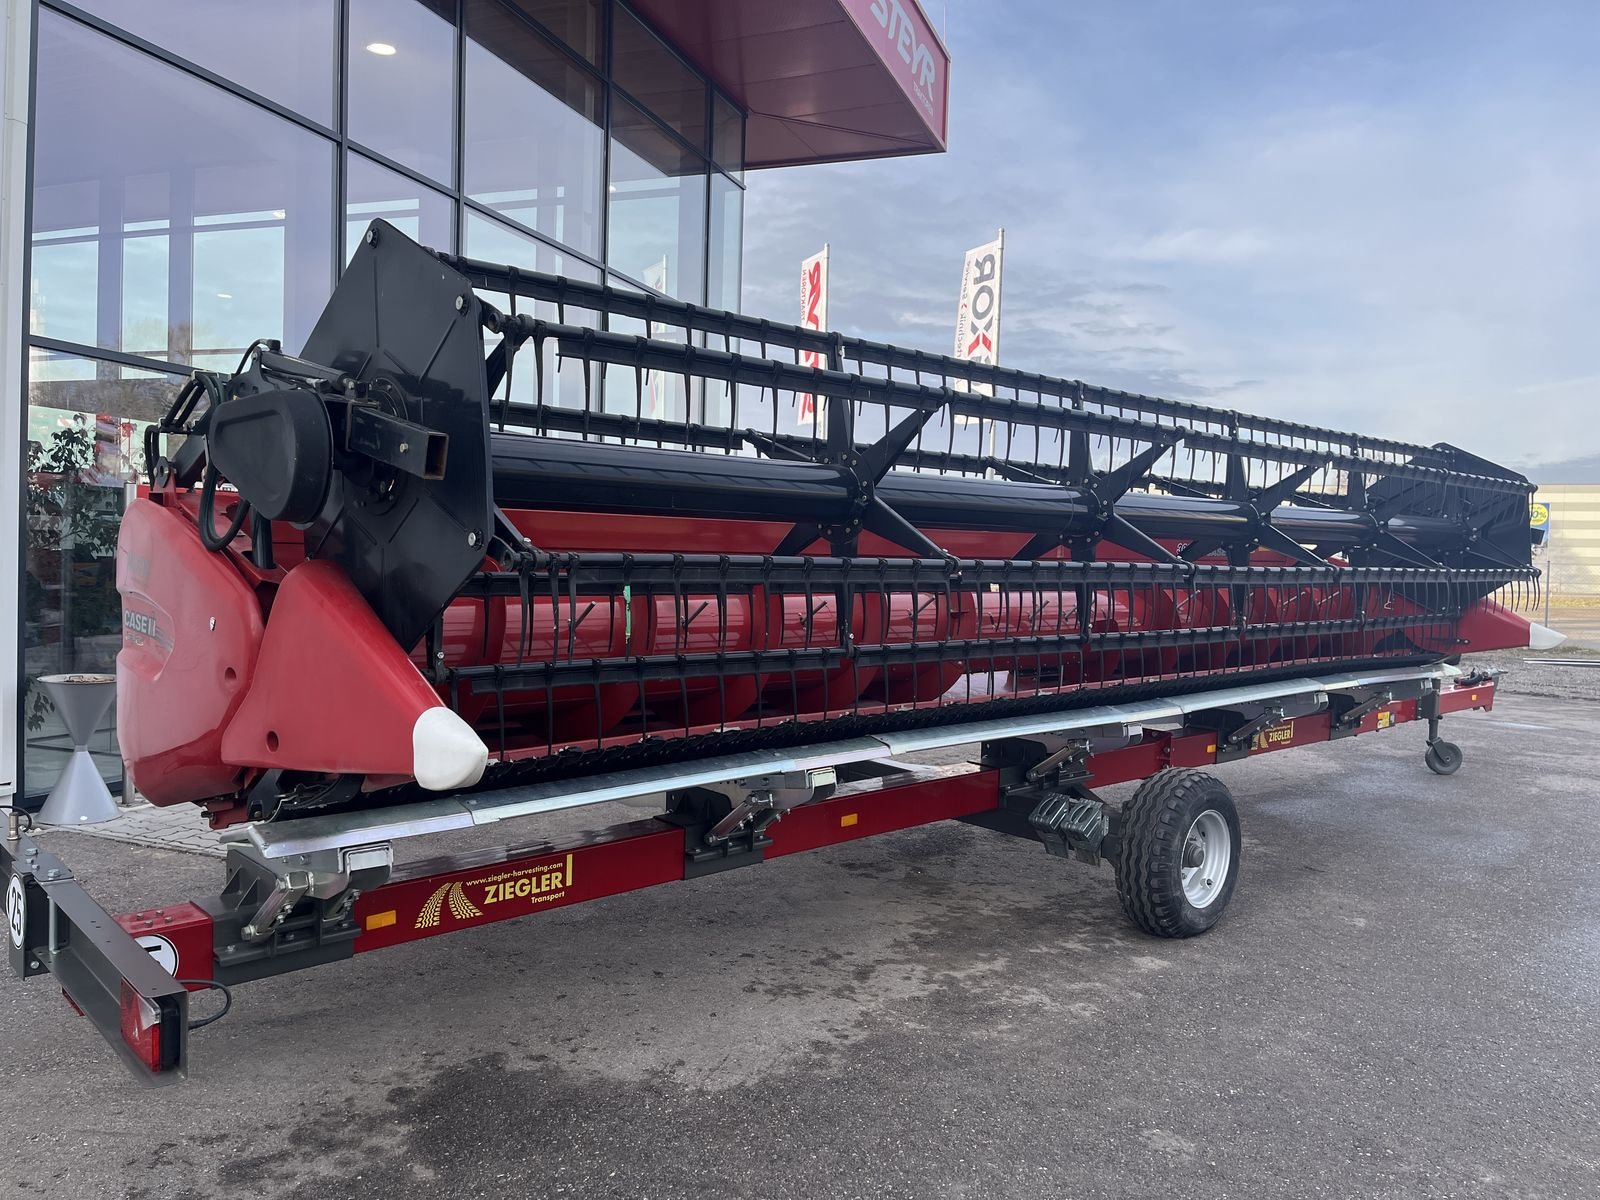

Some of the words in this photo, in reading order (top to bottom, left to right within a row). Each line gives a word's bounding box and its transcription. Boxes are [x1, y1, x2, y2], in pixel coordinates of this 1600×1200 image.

[1269, 729, 1291, 742] ZIEGLER
[466, 862, 563, 887] www.ziegler-harvesting.com
[484, 871, 563, 905] ZIEGLER
[531, 891, 565, 904] Transport
[11, 886, 22, 936] 25
